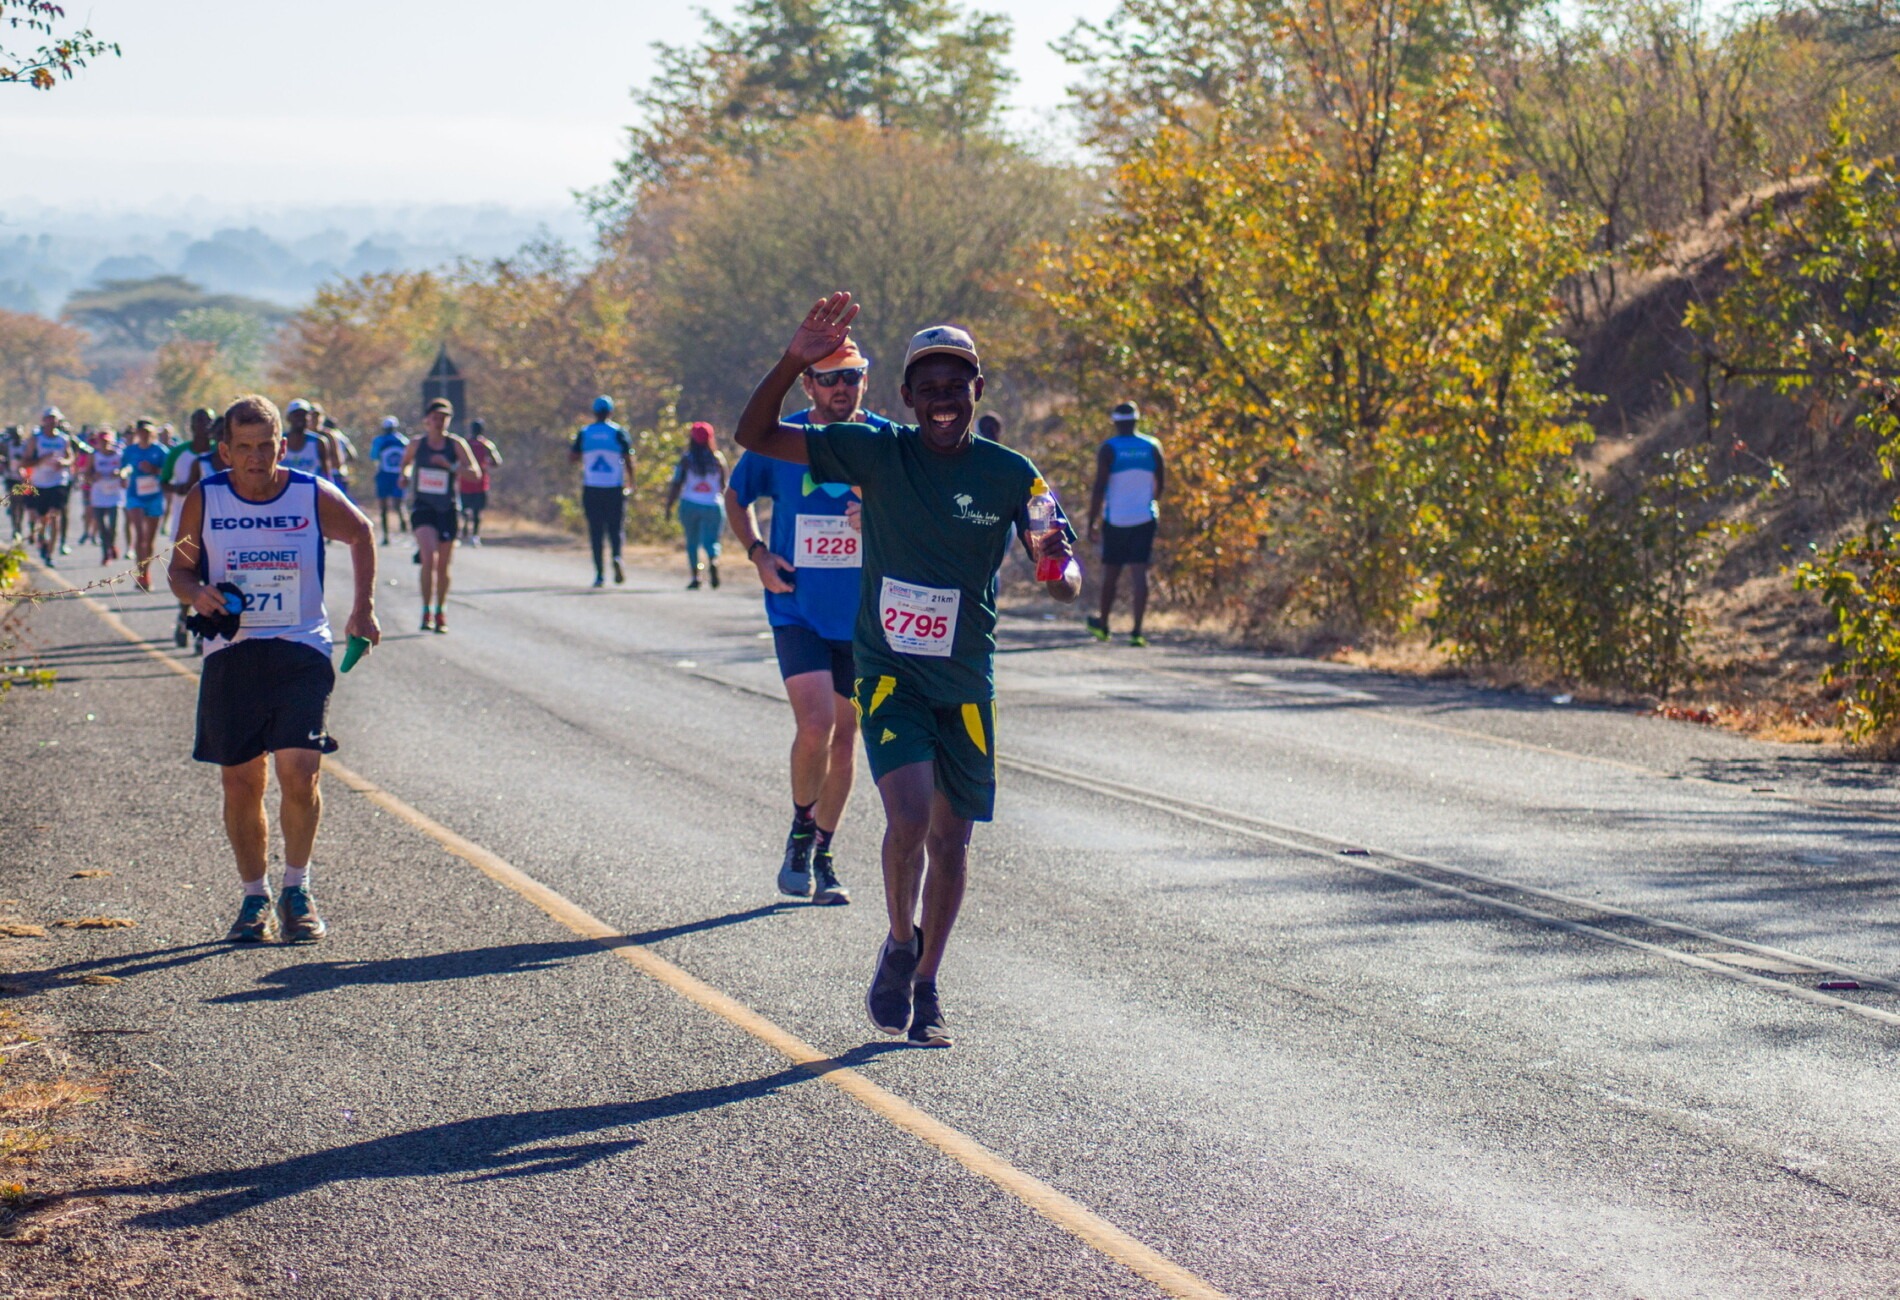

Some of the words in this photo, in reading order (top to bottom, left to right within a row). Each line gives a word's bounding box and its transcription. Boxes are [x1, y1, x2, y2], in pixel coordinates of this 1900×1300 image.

[211, 516, 302, 530] ECONET
[804, 537, 857, 554] 1228
[239, 551, 298, 562] ECONET
[273, 574, 294, 582] 42km
[244, 592, 283, 611] 271
[931, 595, 953, 603] 21km
[884, 607, 948, 639] 2795
